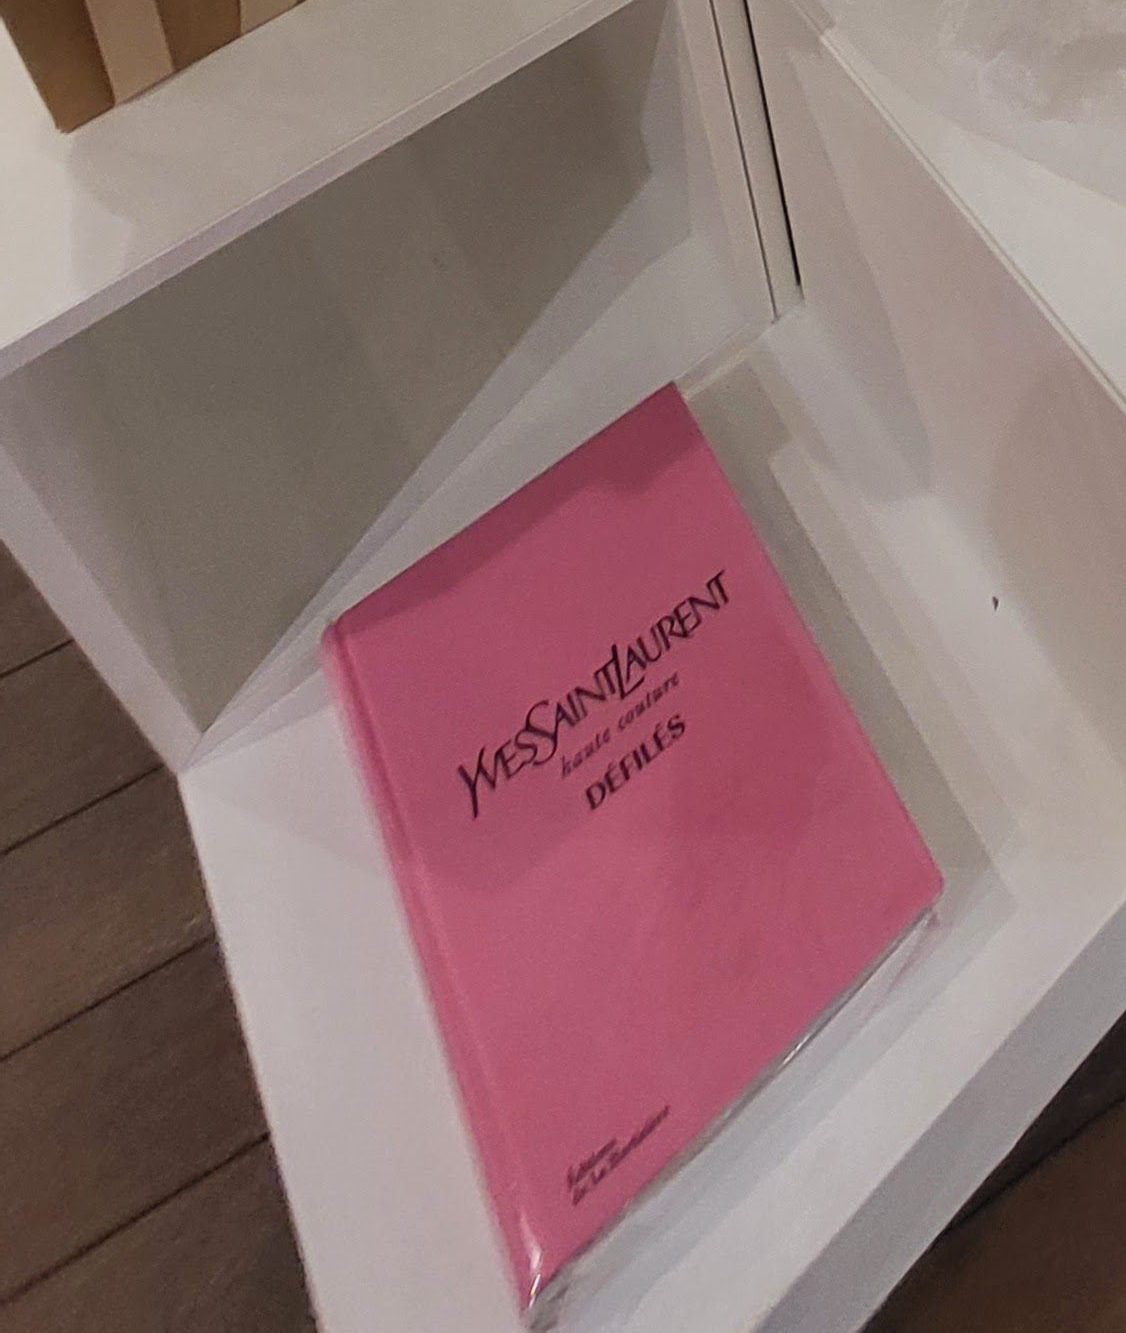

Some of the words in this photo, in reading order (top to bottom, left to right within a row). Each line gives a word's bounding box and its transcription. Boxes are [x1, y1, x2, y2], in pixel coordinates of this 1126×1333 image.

[559, 727, 611, 780] haute
[616, 671, 680, 732] couture
[585, 713, 686, 810] DÉFILÉS
